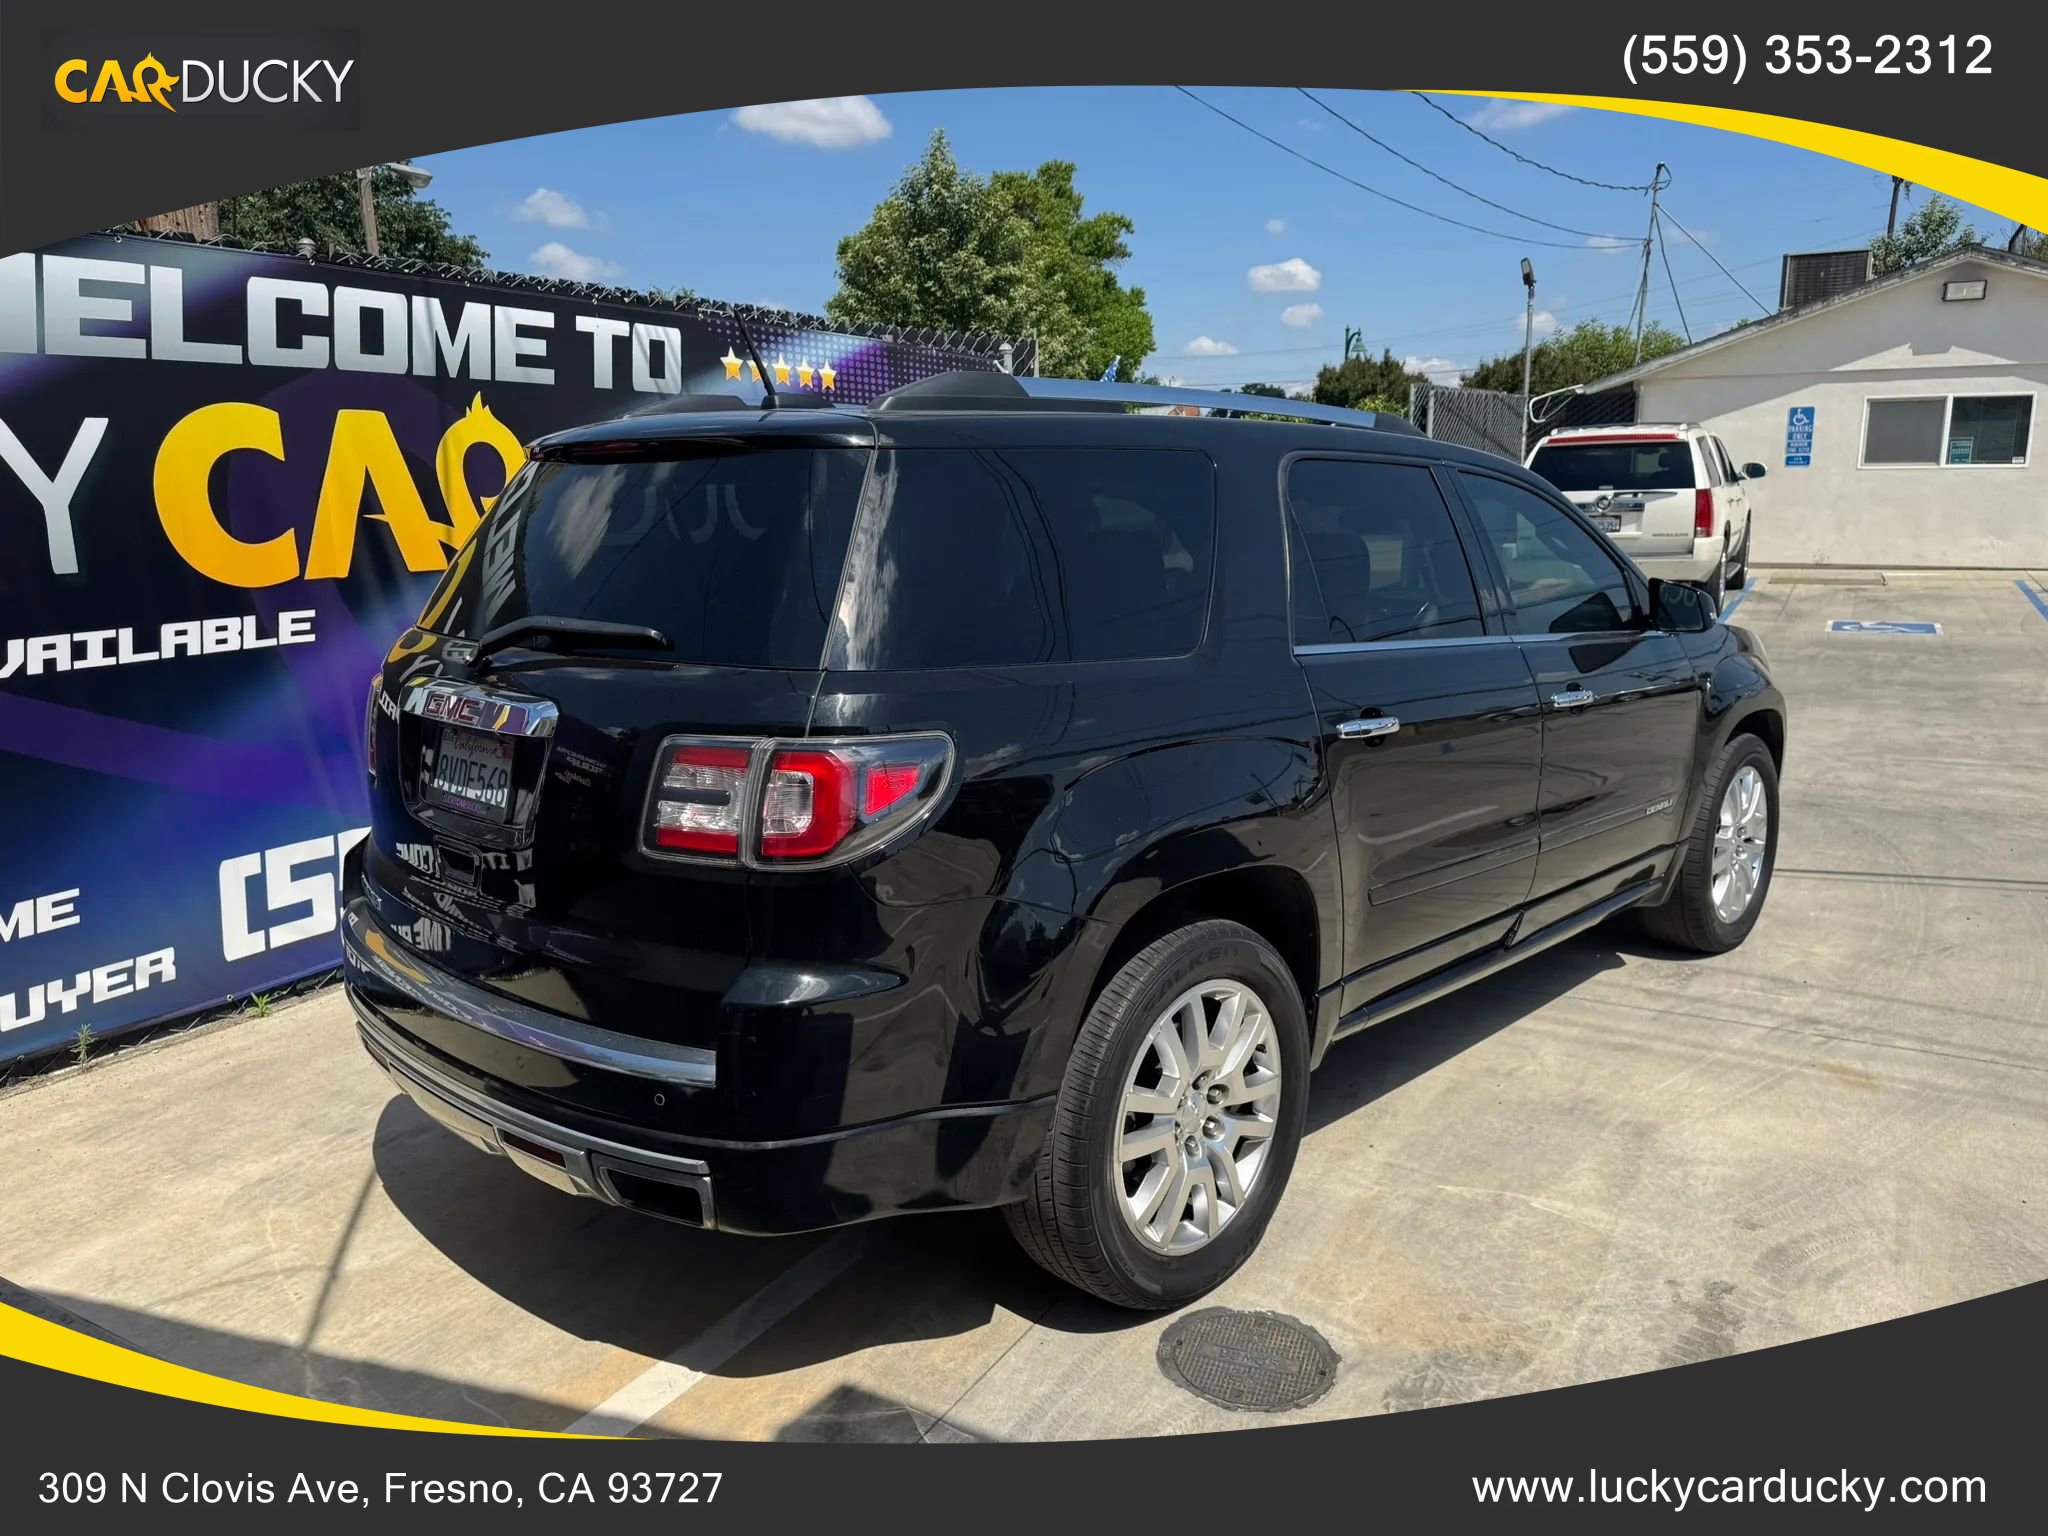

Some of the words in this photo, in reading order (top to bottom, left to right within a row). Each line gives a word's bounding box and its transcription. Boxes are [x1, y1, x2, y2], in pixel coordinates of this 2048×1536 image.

[575, 315, 682, 394] TO
[425, 691, 486, 726] GMC
[454, 735, 499, 758] California
[219, 826, 372, 962] (5
